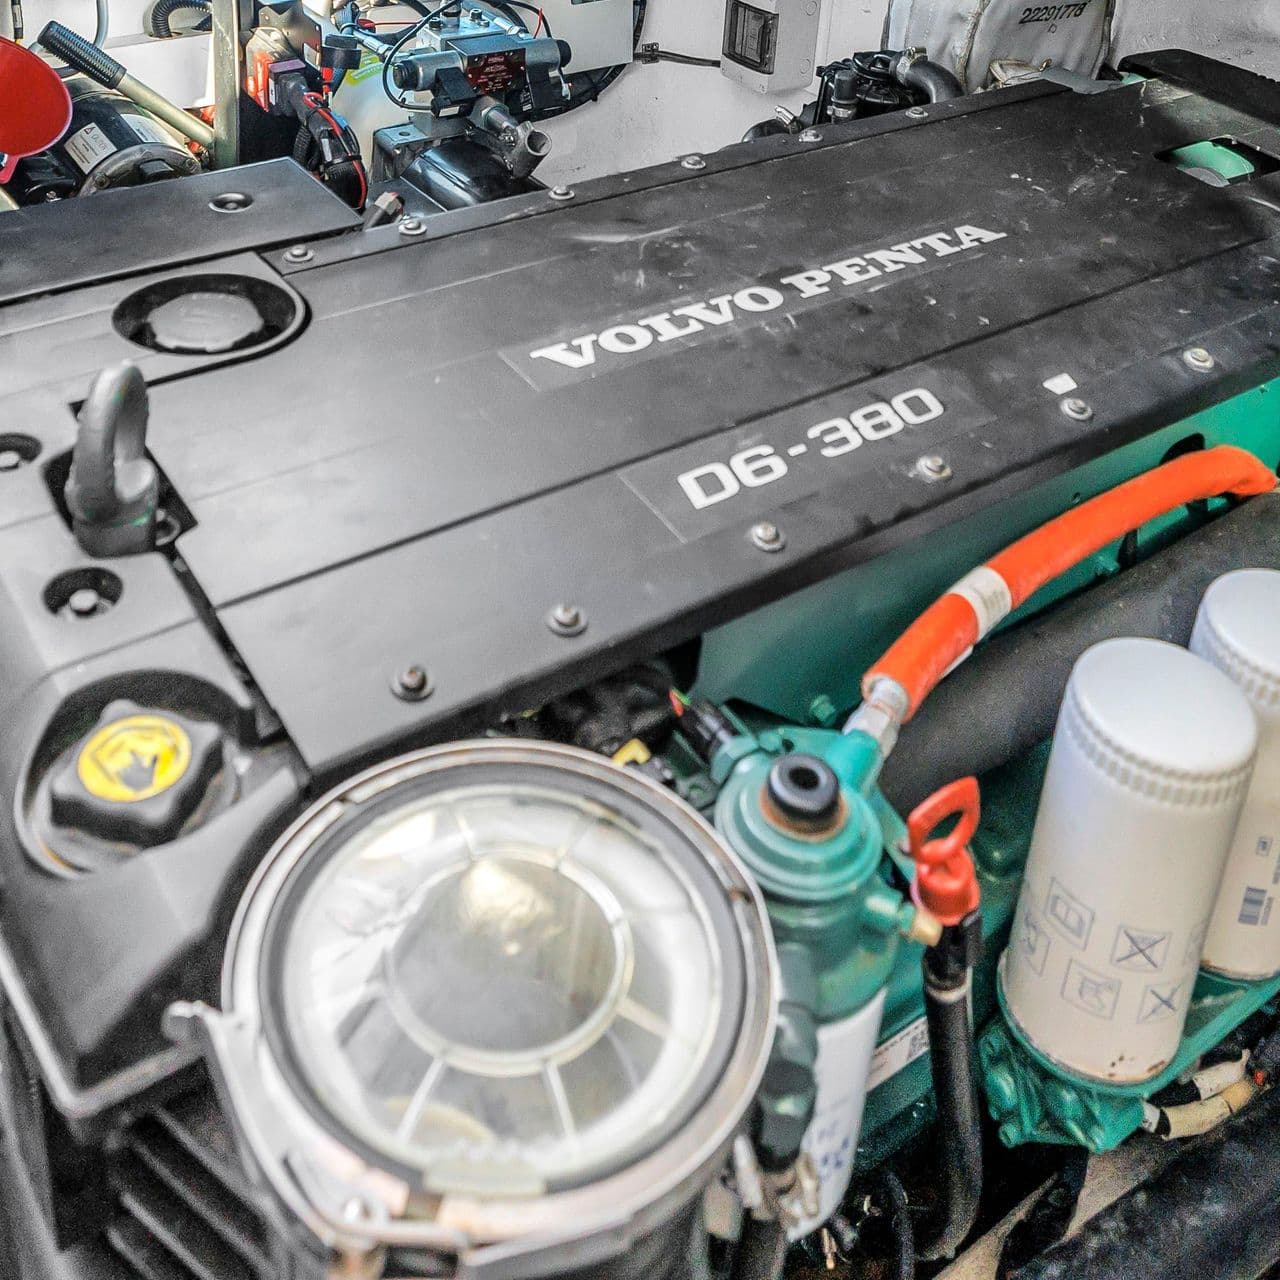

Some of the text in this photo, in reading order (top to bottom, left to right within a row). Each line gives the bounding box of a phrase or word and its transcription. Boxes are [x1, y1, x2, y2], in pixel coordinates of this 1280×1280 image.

[530, 224, 1008, 370] VOLVO PENTA
[677, 387, 946, 510] D6-380
